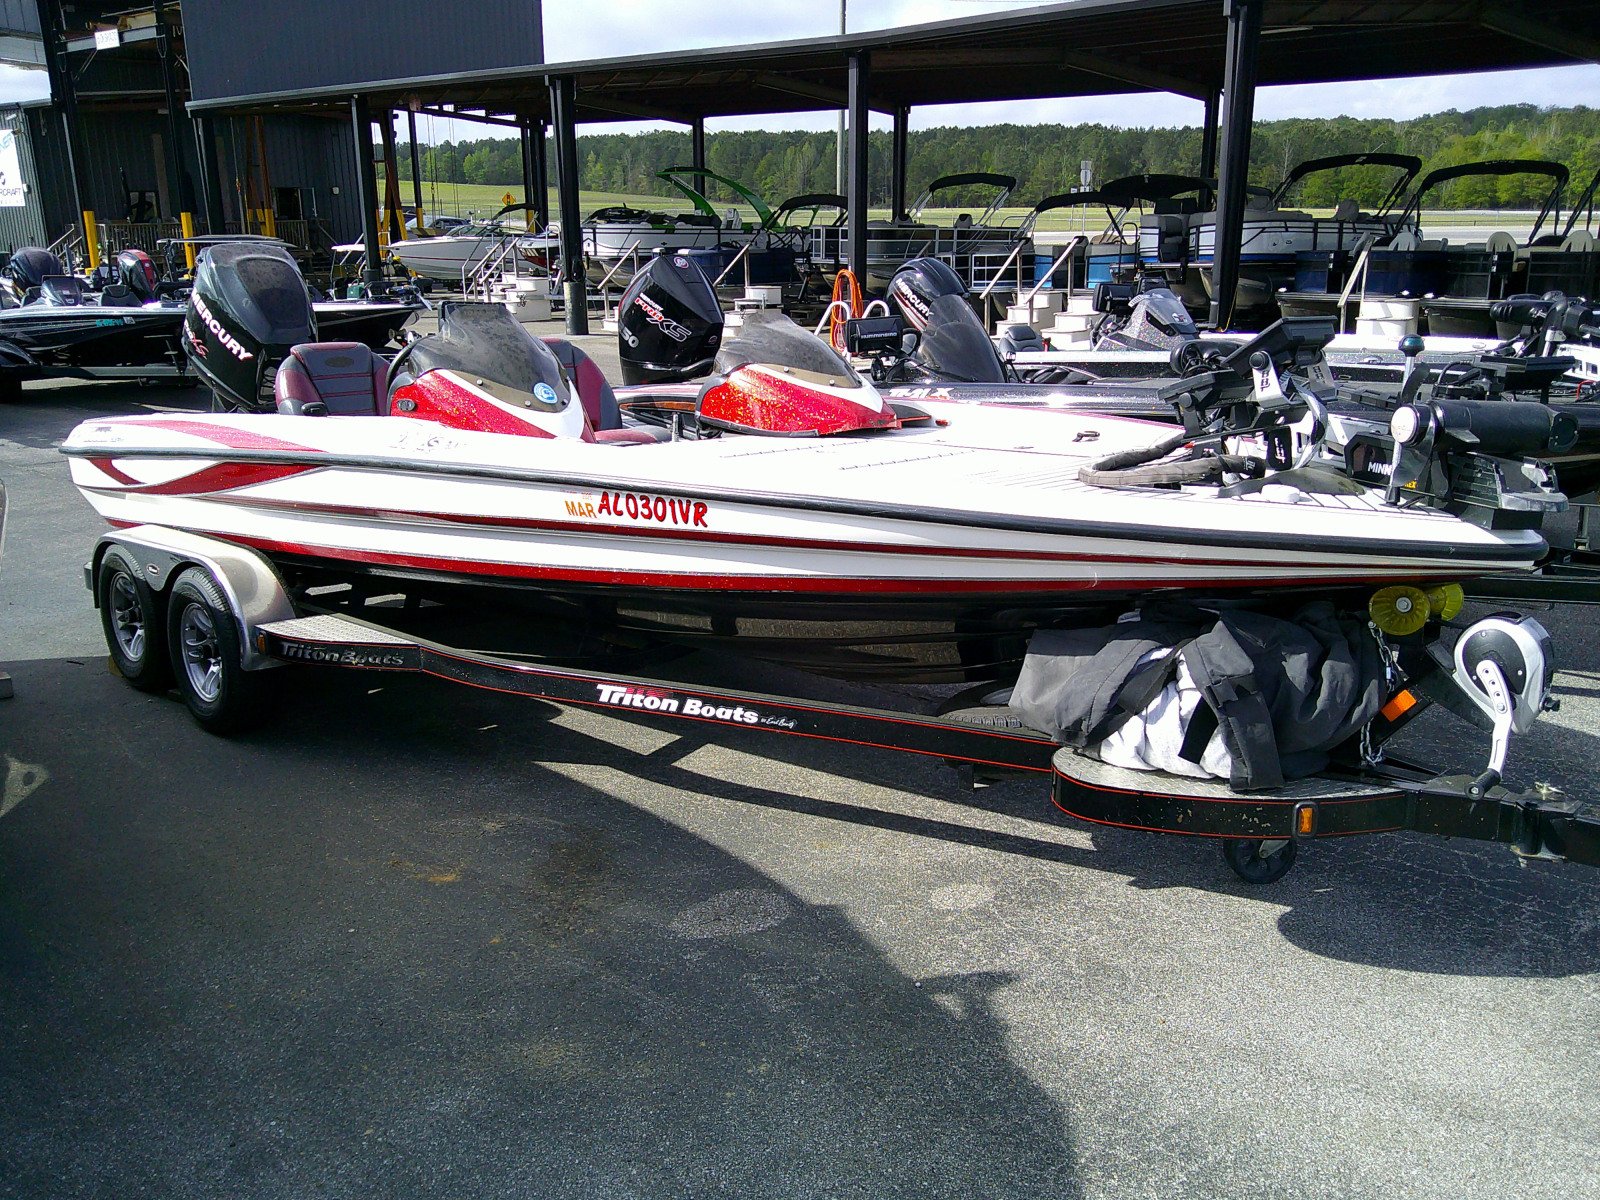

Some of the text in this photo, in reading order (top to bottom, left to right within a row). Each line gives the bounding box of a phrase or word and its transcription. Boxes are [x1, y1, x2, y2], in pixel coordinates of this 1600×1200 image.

[896, 278, 935, 317] MERCURY
[191, 286, 254, 360] MERCURY
[598, 491, 708, 528] AL0301VR
[596, 684, 679, 712] Triton
[682, 698, 759, 724] Boats
